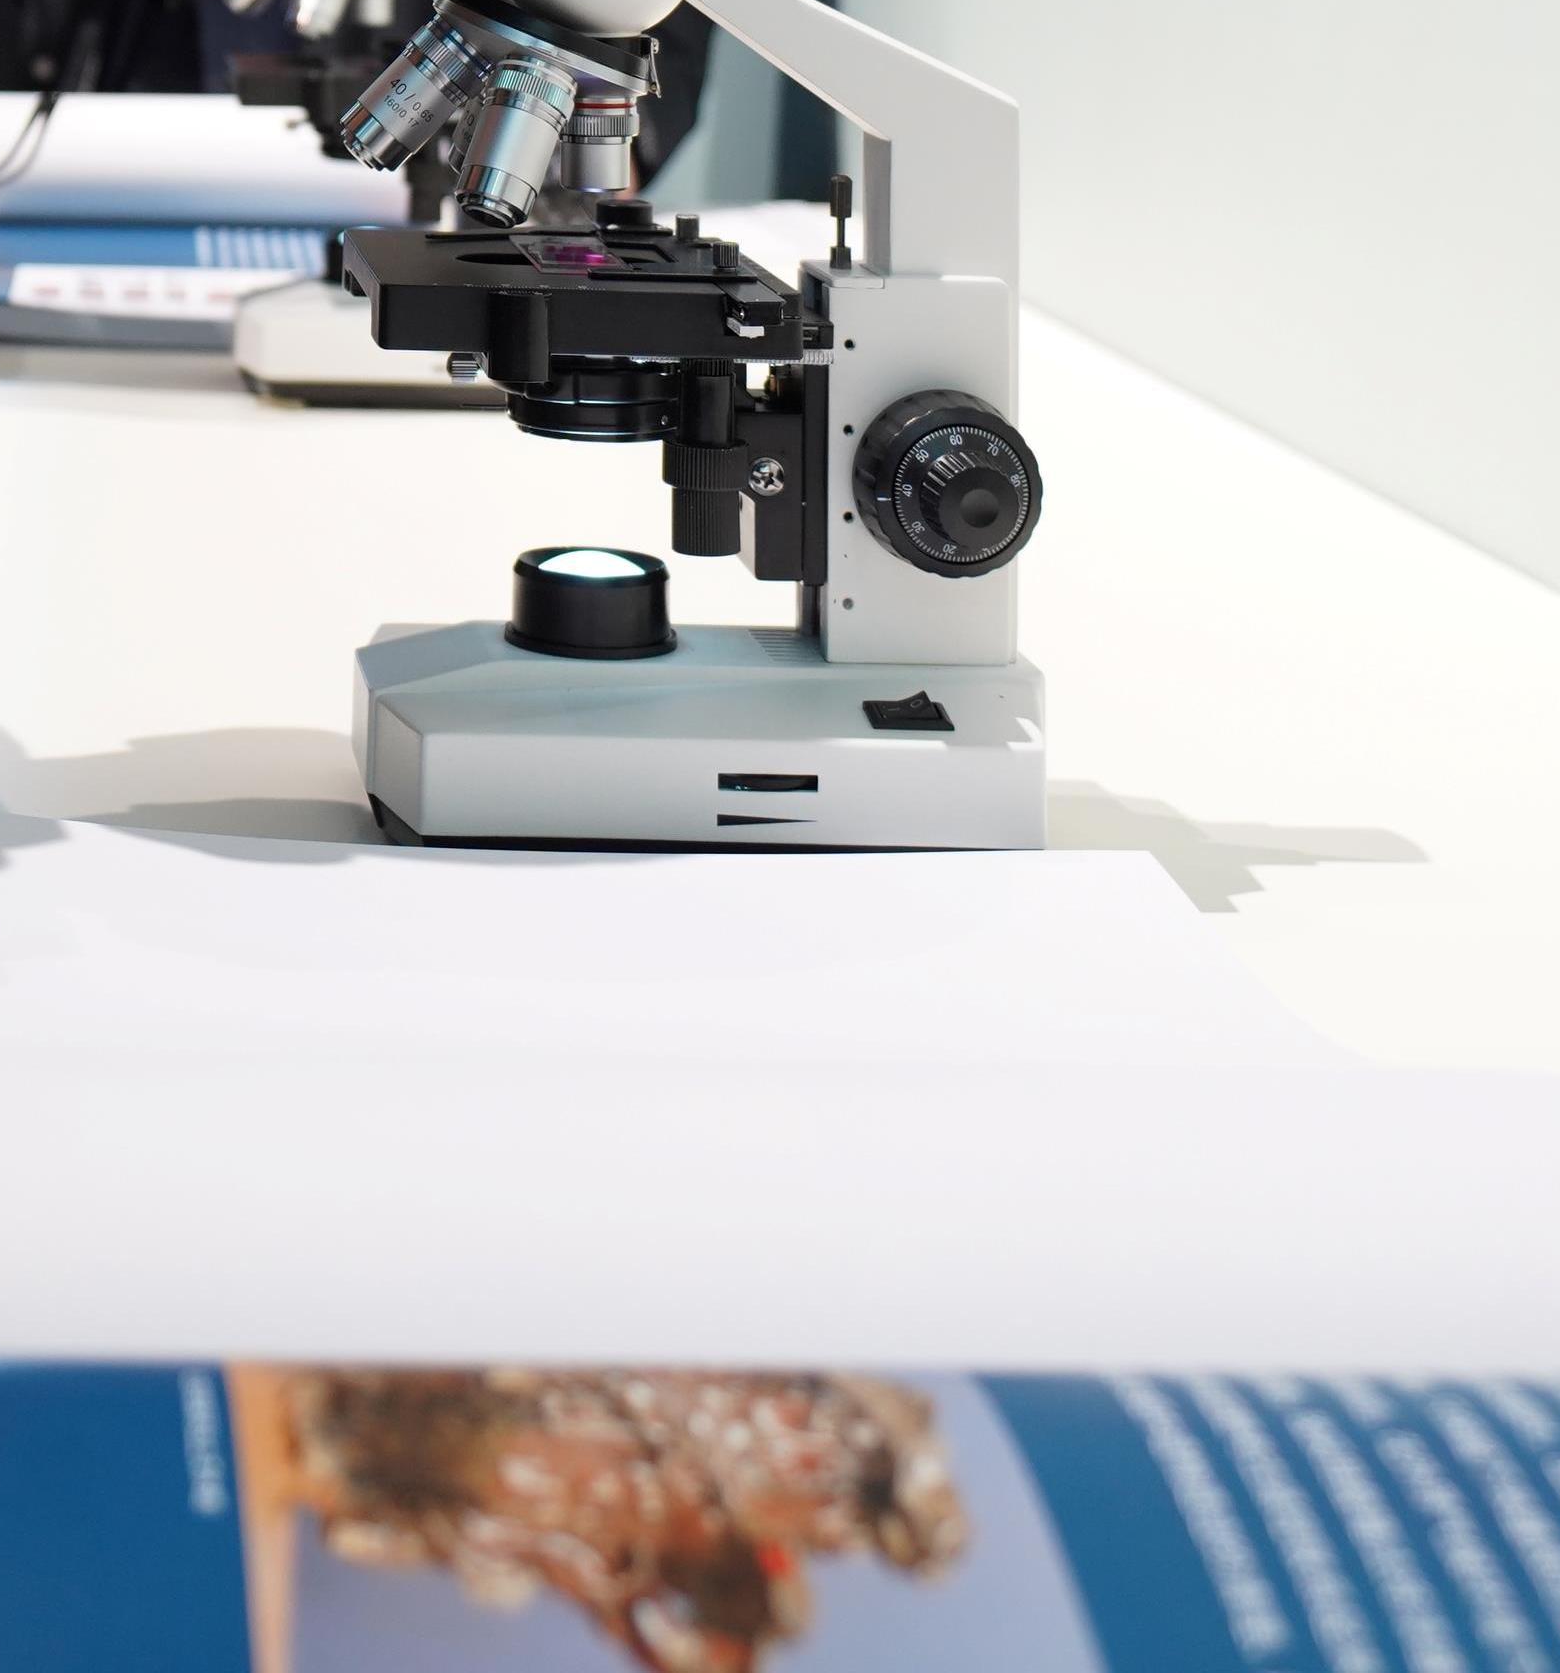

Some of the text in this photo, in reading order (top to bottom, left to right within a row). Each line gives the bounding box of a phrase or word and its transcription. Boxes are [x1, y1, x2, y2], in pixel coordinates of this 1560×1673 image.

[949, 434, 963, 446] 60
[915, 449, 929, 463] 50
[987, 442, 999, 456] 70
[902, 483, 913, 497] 40
[911, 520, 926, 534] 30
[943, 543, 958, 555] 20
